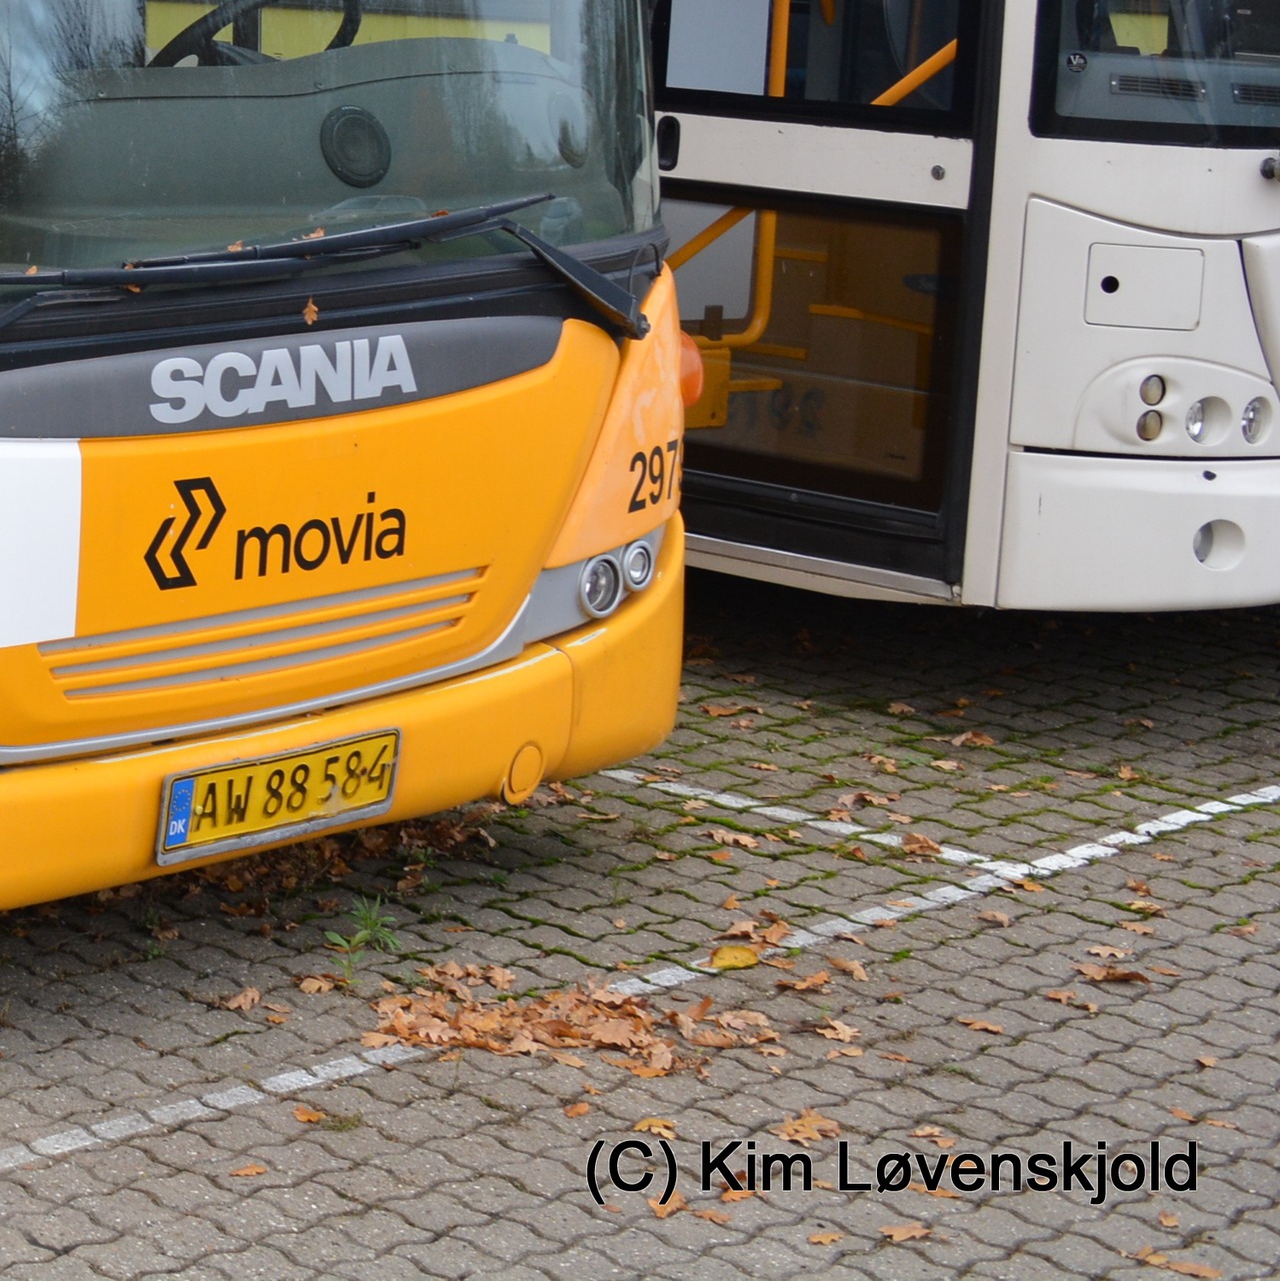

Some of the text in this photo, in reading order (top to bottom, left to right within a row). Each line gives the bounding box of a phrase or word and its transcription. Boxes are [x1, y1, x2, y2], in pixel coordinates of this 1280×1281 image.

[149, 334, 418, 424] SCANIA
[627, 438, 681, 514] 297
[234, 491, 406, 580] movia
[169, 818, 186, 835] DK
[194, 775, 254, 832] AW
[263, 763, 310, 817] 88
